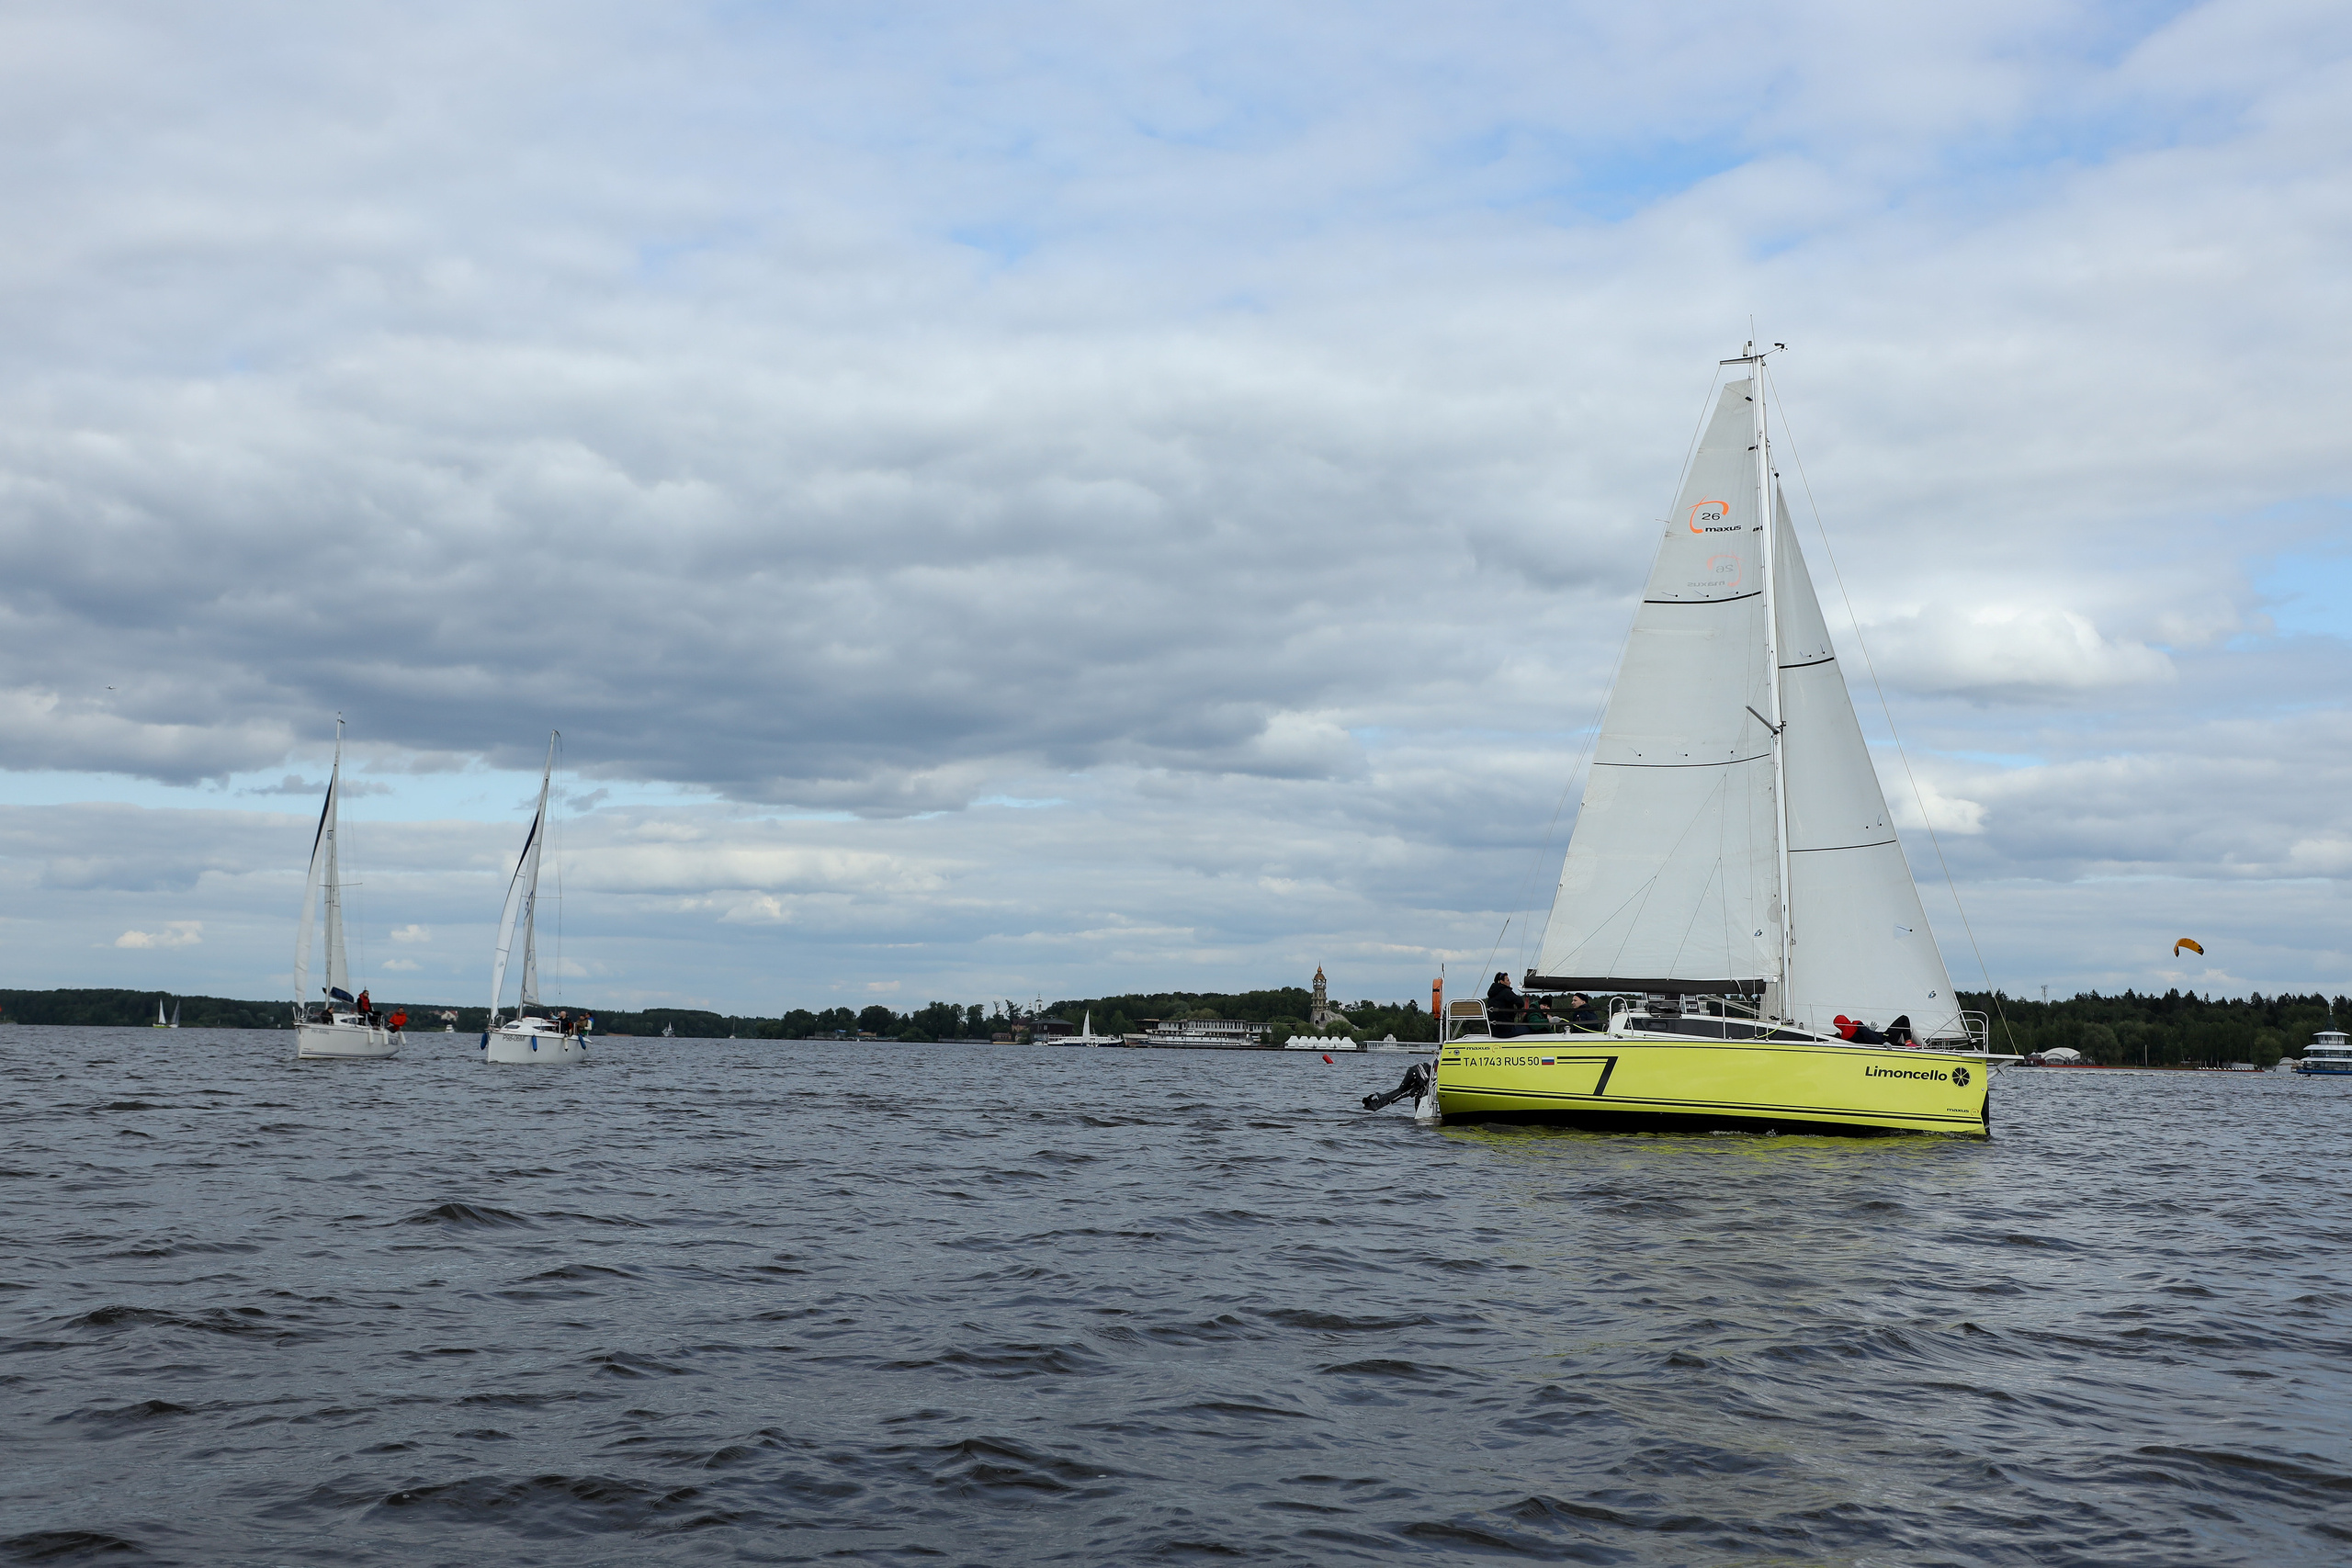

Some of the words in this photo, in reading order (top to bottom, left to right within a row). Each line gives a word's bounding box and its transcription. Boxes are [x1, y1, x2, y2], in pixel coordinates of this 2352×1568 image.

[1701, 512, 1721, 521] 26
[1705, 525, 1742, 533] maxus
[1504, 1056, 1526, 1066] RUS
[1865, 1066, 1948, 1081] Limoncello
